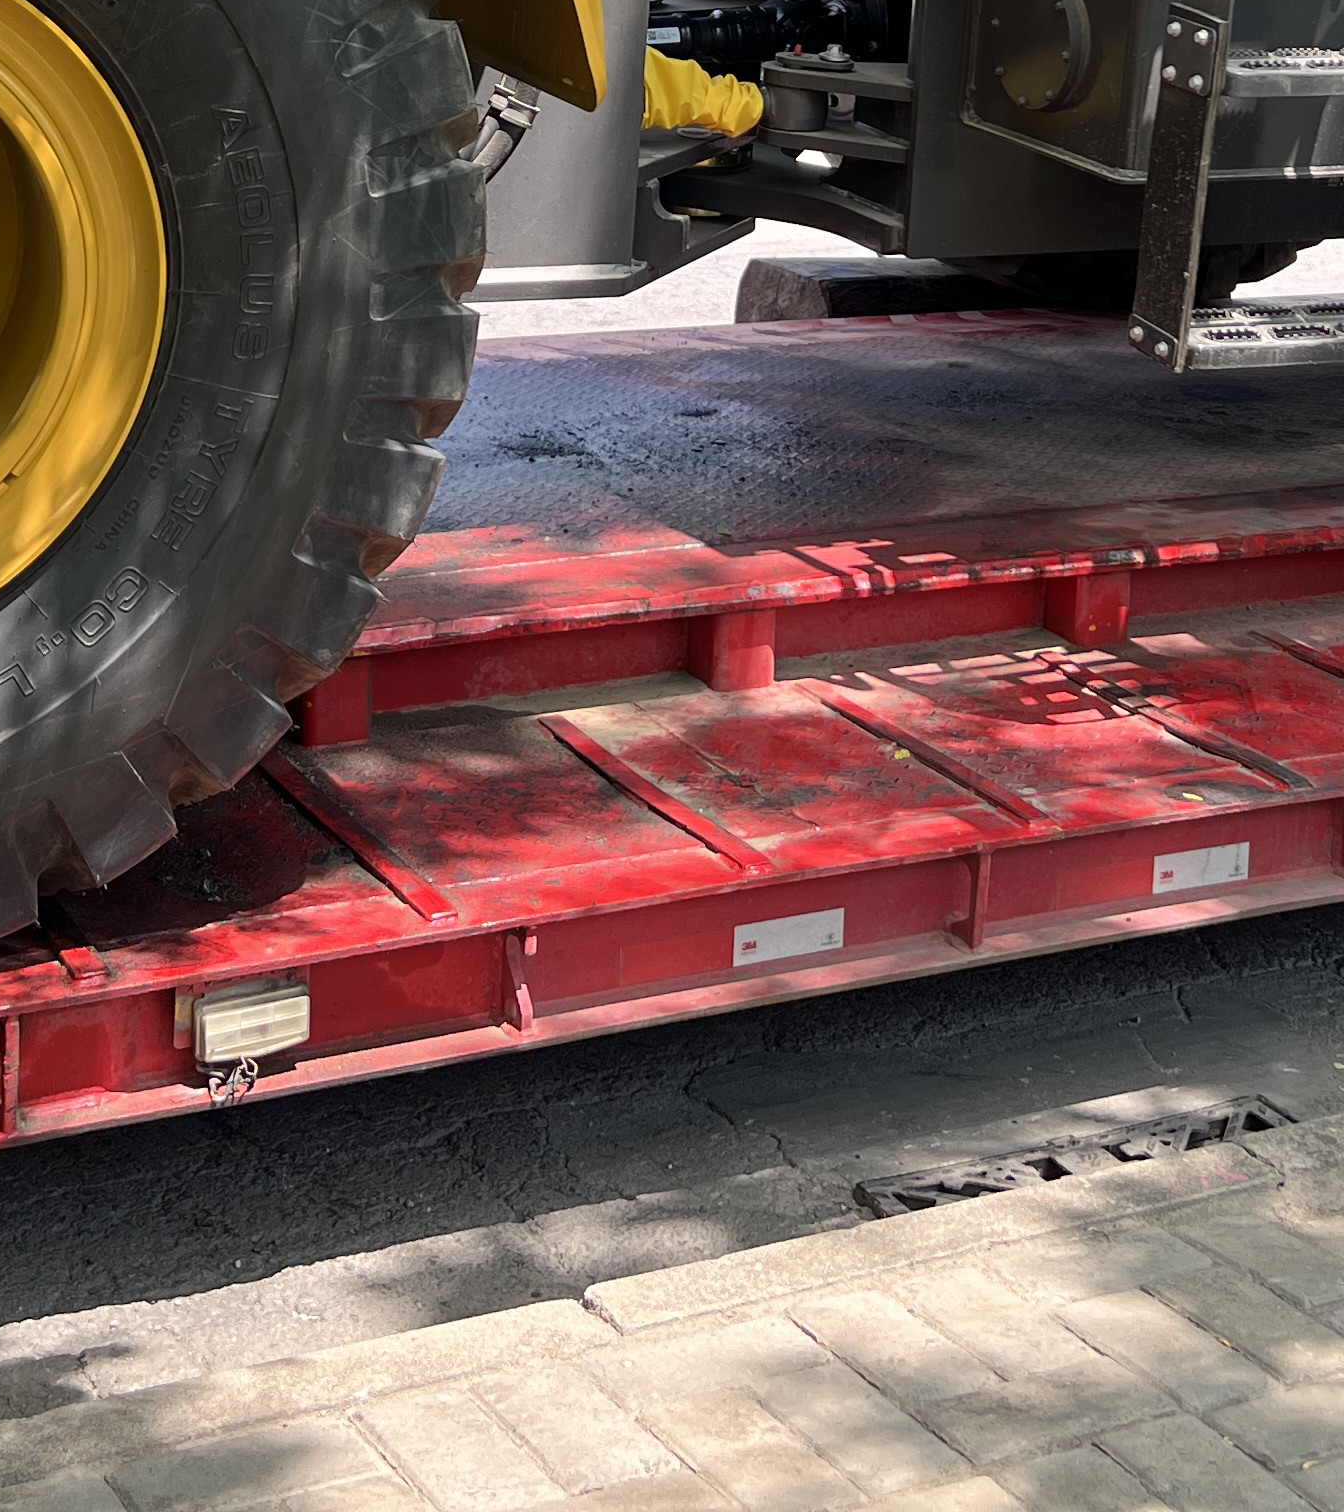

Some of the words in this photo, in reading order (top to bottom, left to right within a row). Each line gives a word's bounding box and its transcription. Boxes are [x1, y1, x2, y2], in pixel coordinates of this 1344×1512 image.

[208, 103, 276, 361] AEOLUS
[148, 394, 194, 480] JIAOZUO
[150, 397, 256, 552] TYRE
[95, 496, 141, 552] CHINA
[1159, 869, 1174, 879] 3M
[741, 940, 757, 950] 3M
